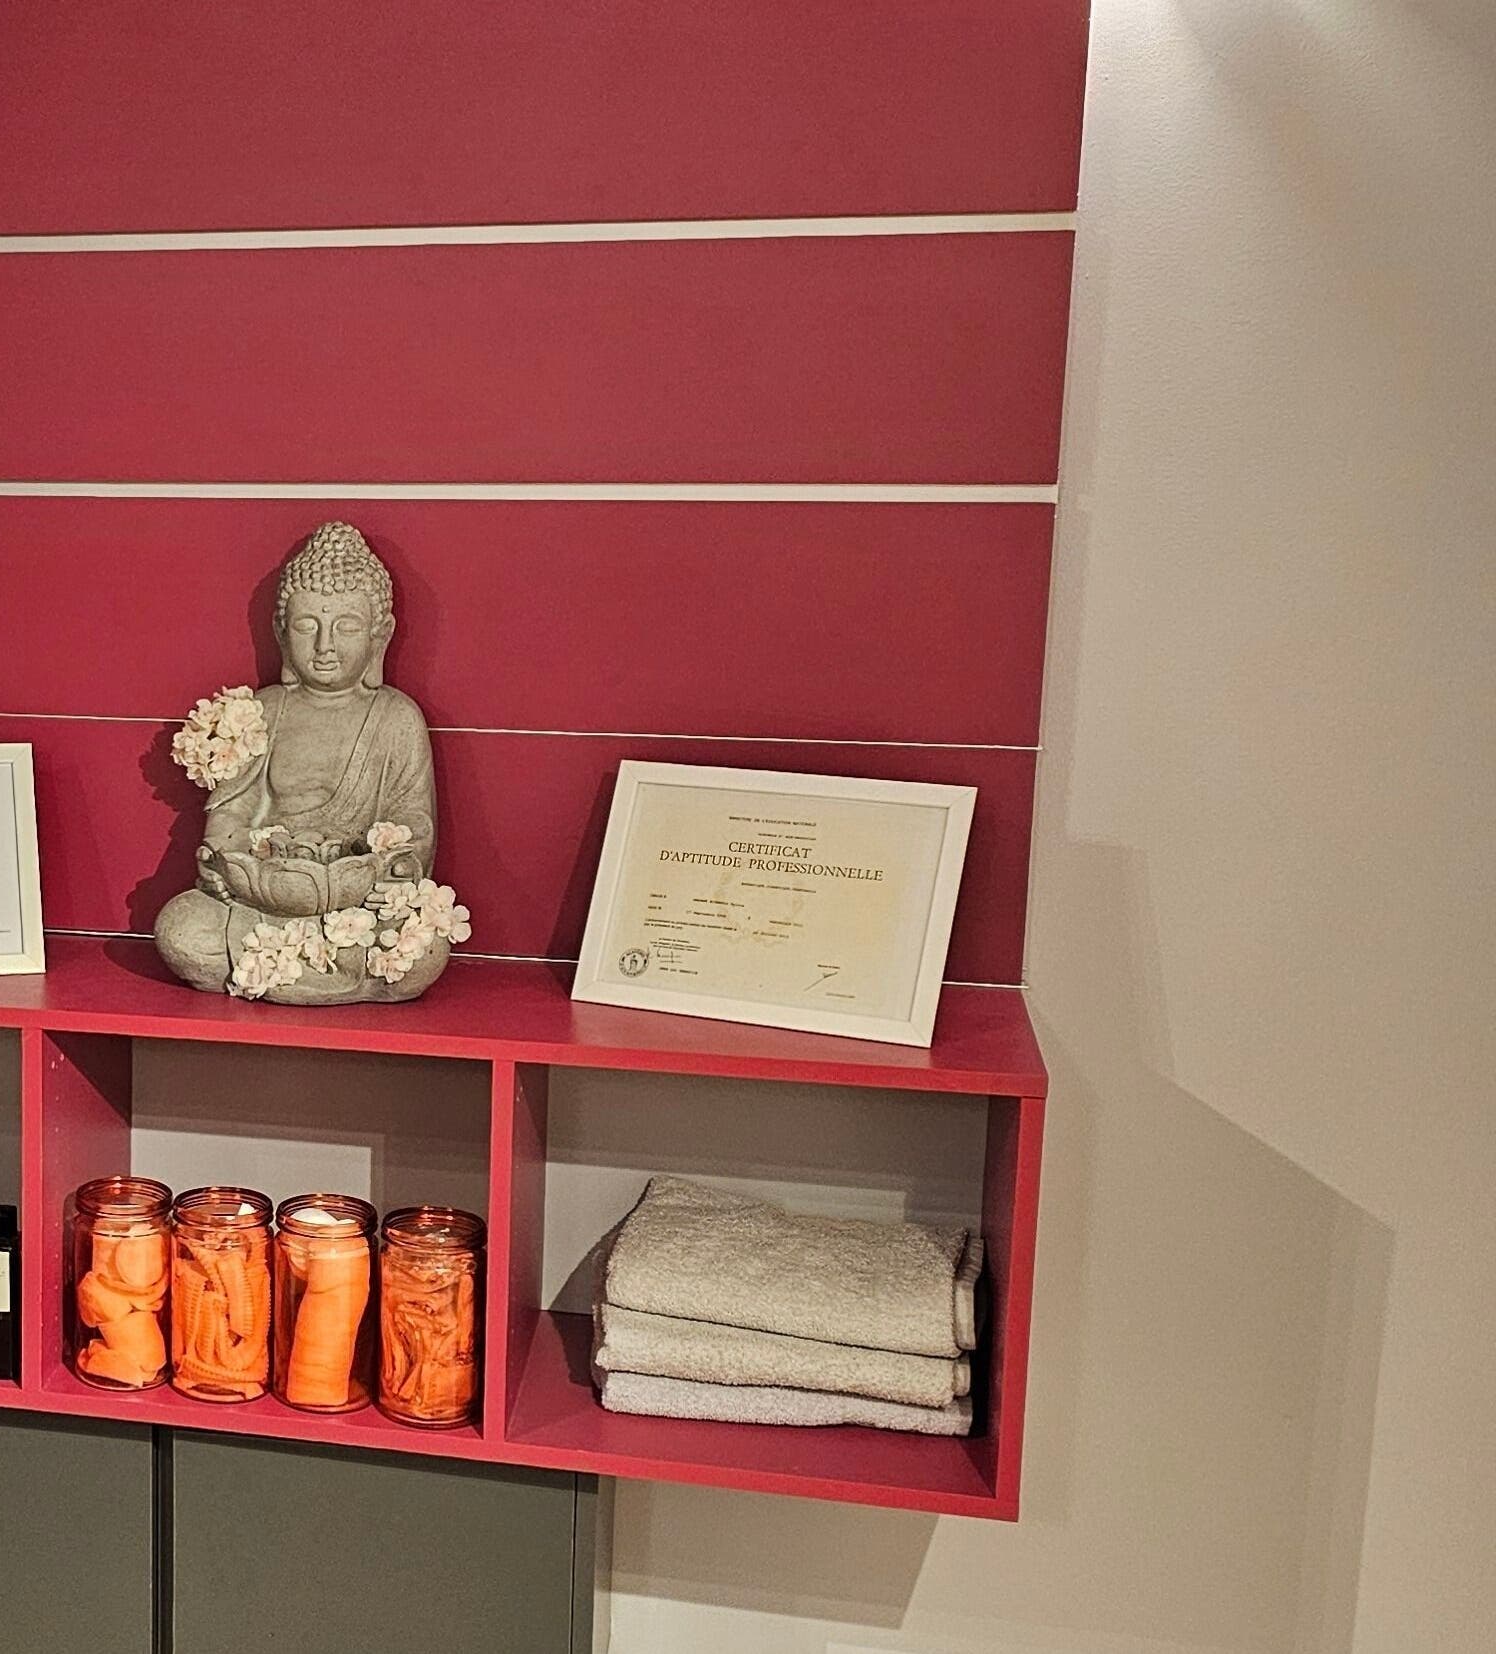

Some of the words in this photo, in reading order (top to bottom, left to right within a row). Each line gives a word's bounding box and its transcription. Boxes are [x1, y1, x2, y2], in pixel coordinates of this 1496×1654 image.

[728, 841, 813, 859] CERTIFICAT
[659, 849, 742, 869] D'APTITUDE
[748, 858, 884, 882] PROFESSIONNELLE
